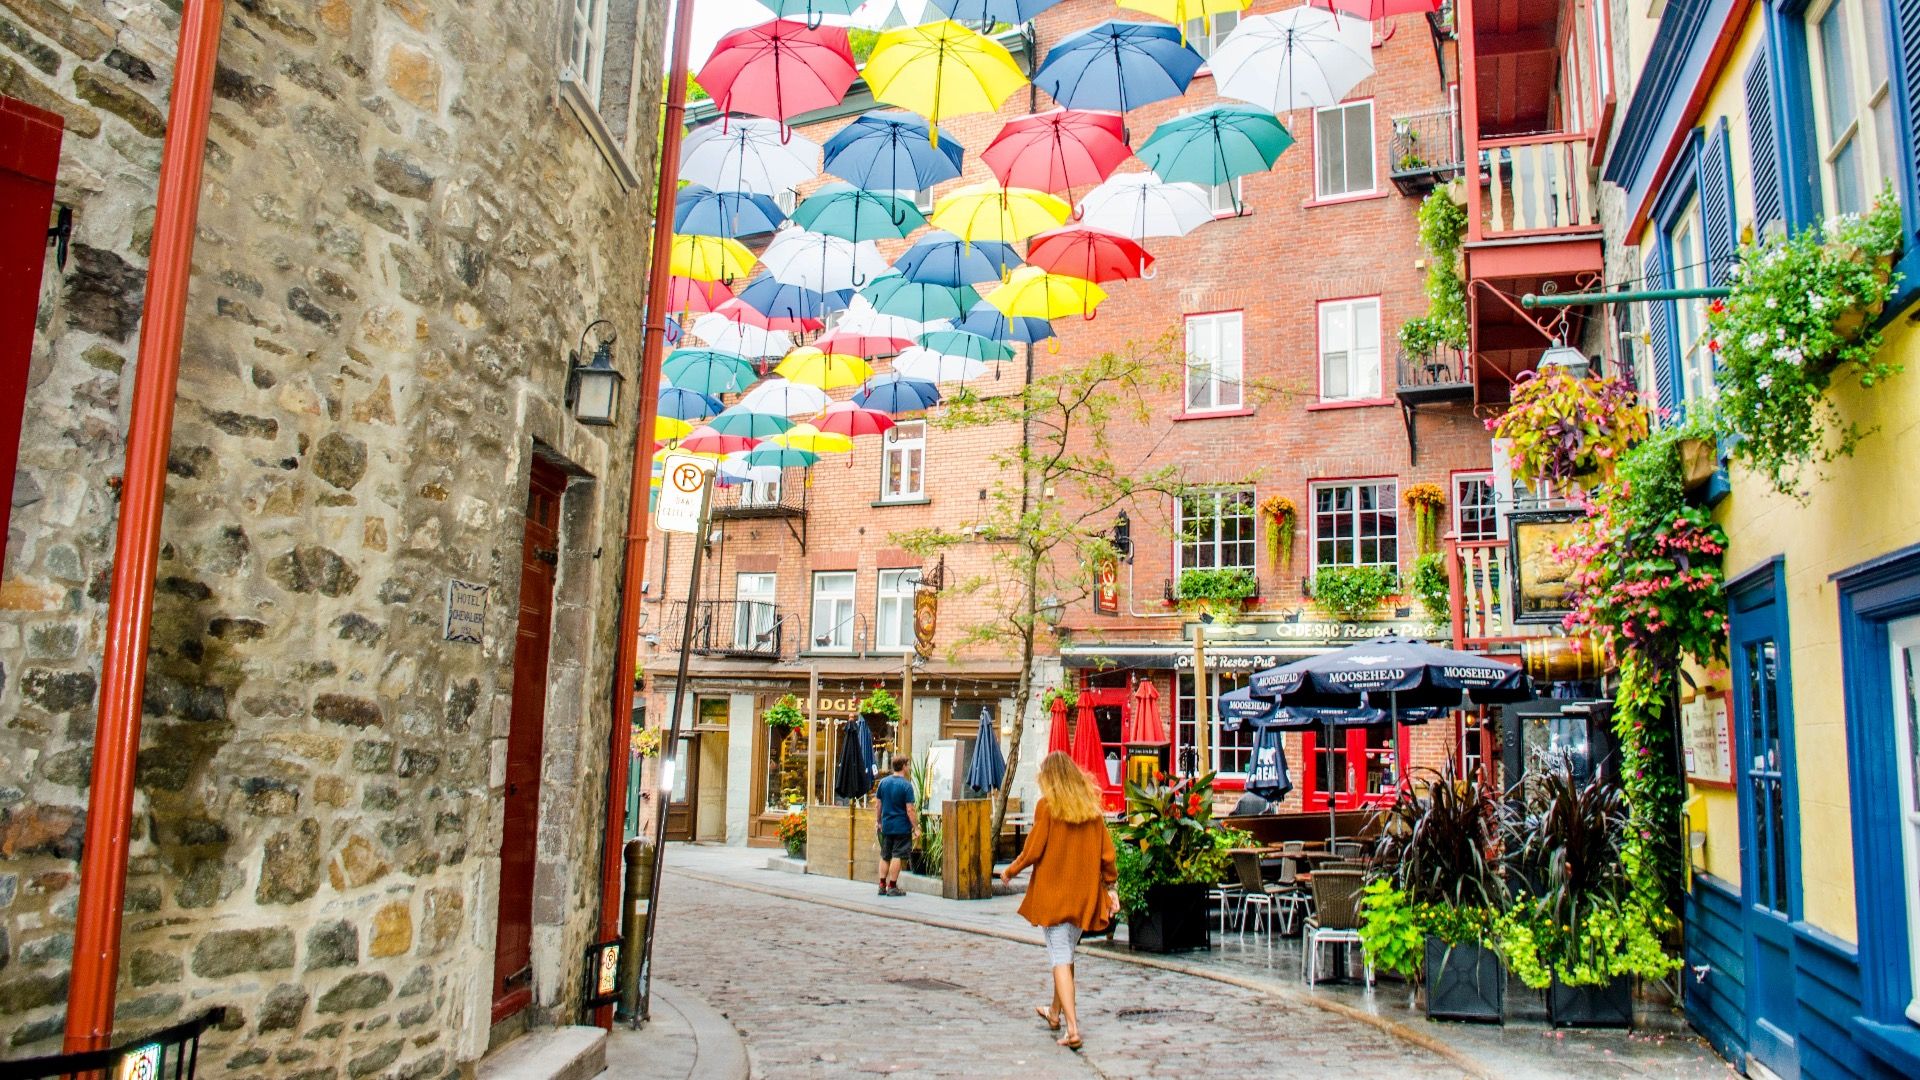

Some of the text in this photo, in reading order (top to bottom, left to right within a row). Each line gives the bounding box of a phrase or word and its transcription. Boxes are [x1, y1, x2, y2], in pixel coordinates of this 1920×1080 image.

[1258, 672, 1298, 687] MOOSEHEAD
[1328, 669, 1405, 684] MOOSEHEAD
[1443, 666, 1506, 680] MOOSEHEAD
[1228, 700, 1272, 712] MOOSEHEAD
